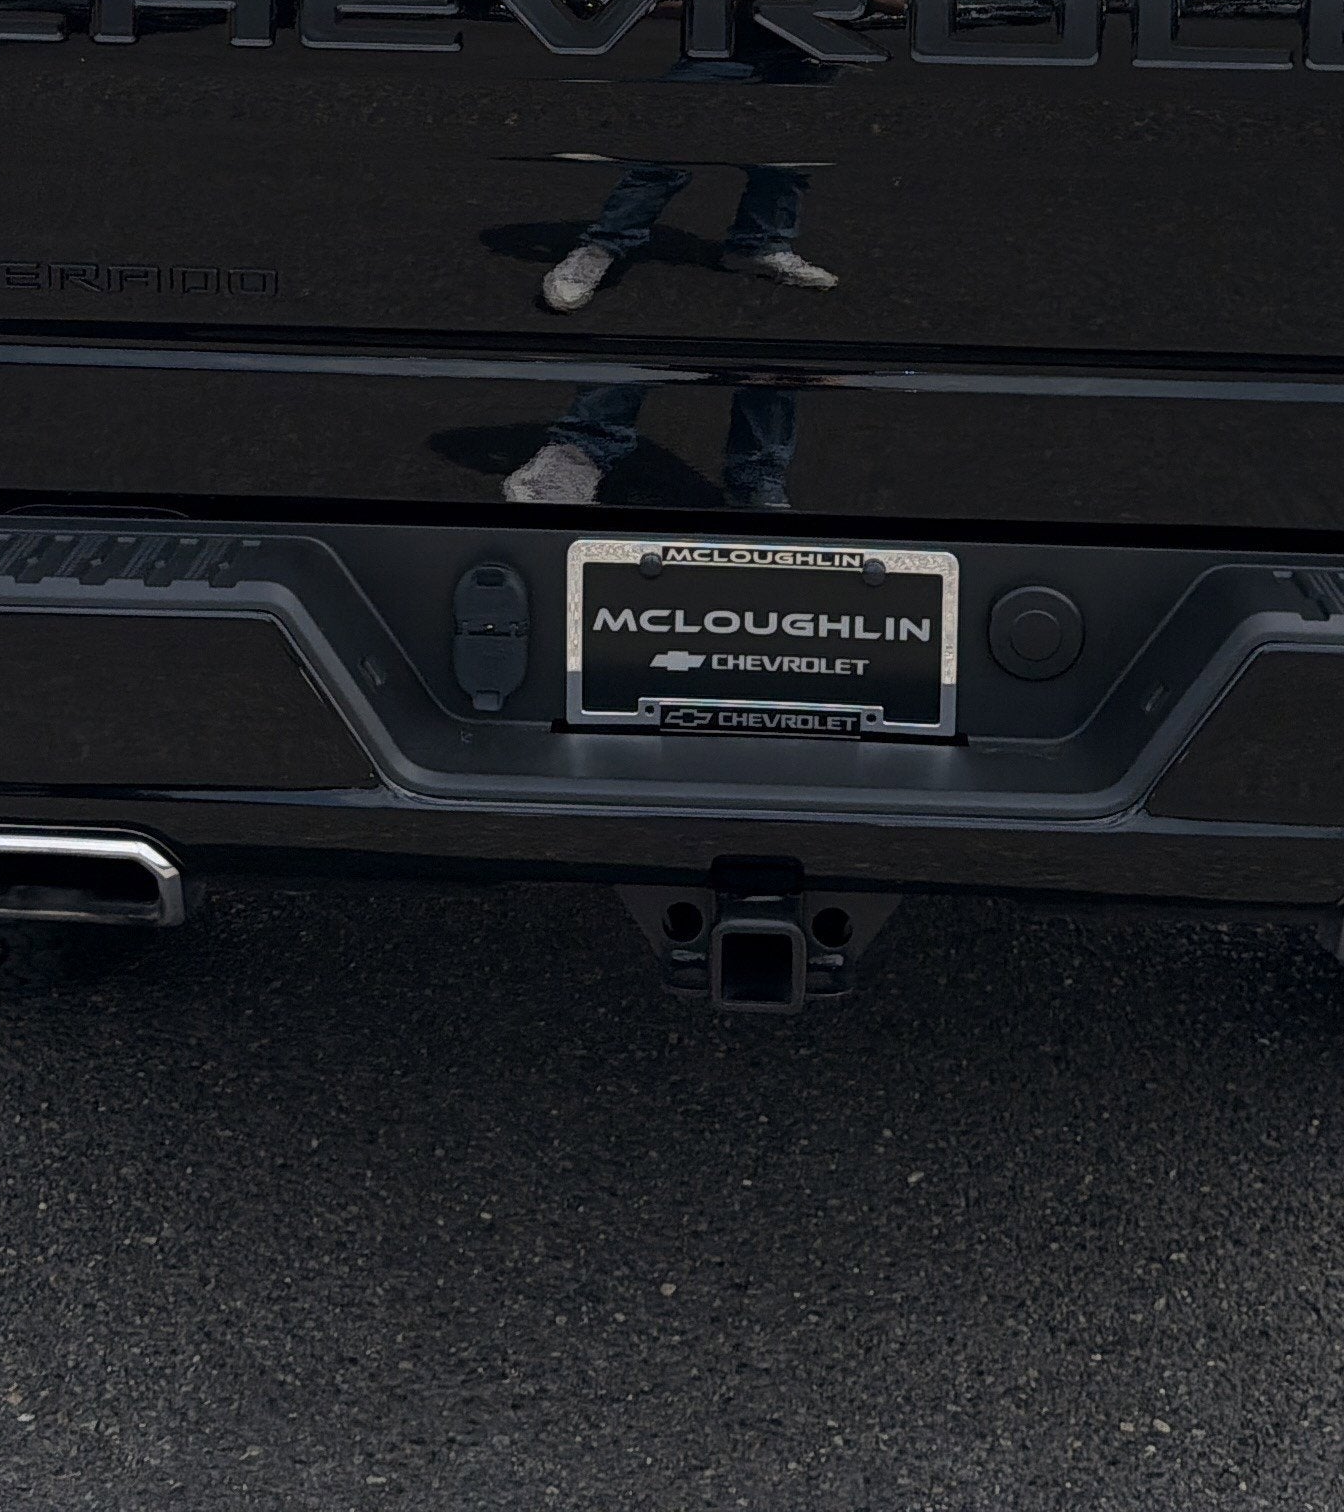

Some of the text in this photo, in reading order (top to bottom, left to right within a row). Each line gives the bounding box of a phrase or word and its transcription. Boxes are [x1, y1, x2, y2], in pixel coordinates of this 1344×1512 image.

[665, 548, 861, 568] MCLOUGHLIN
[592, 607, 931, 642] MCLOUGHLIN
[711, 654, 870, 676] CHEVROLET
[718, 711, 858, 732] CHEVROLET
